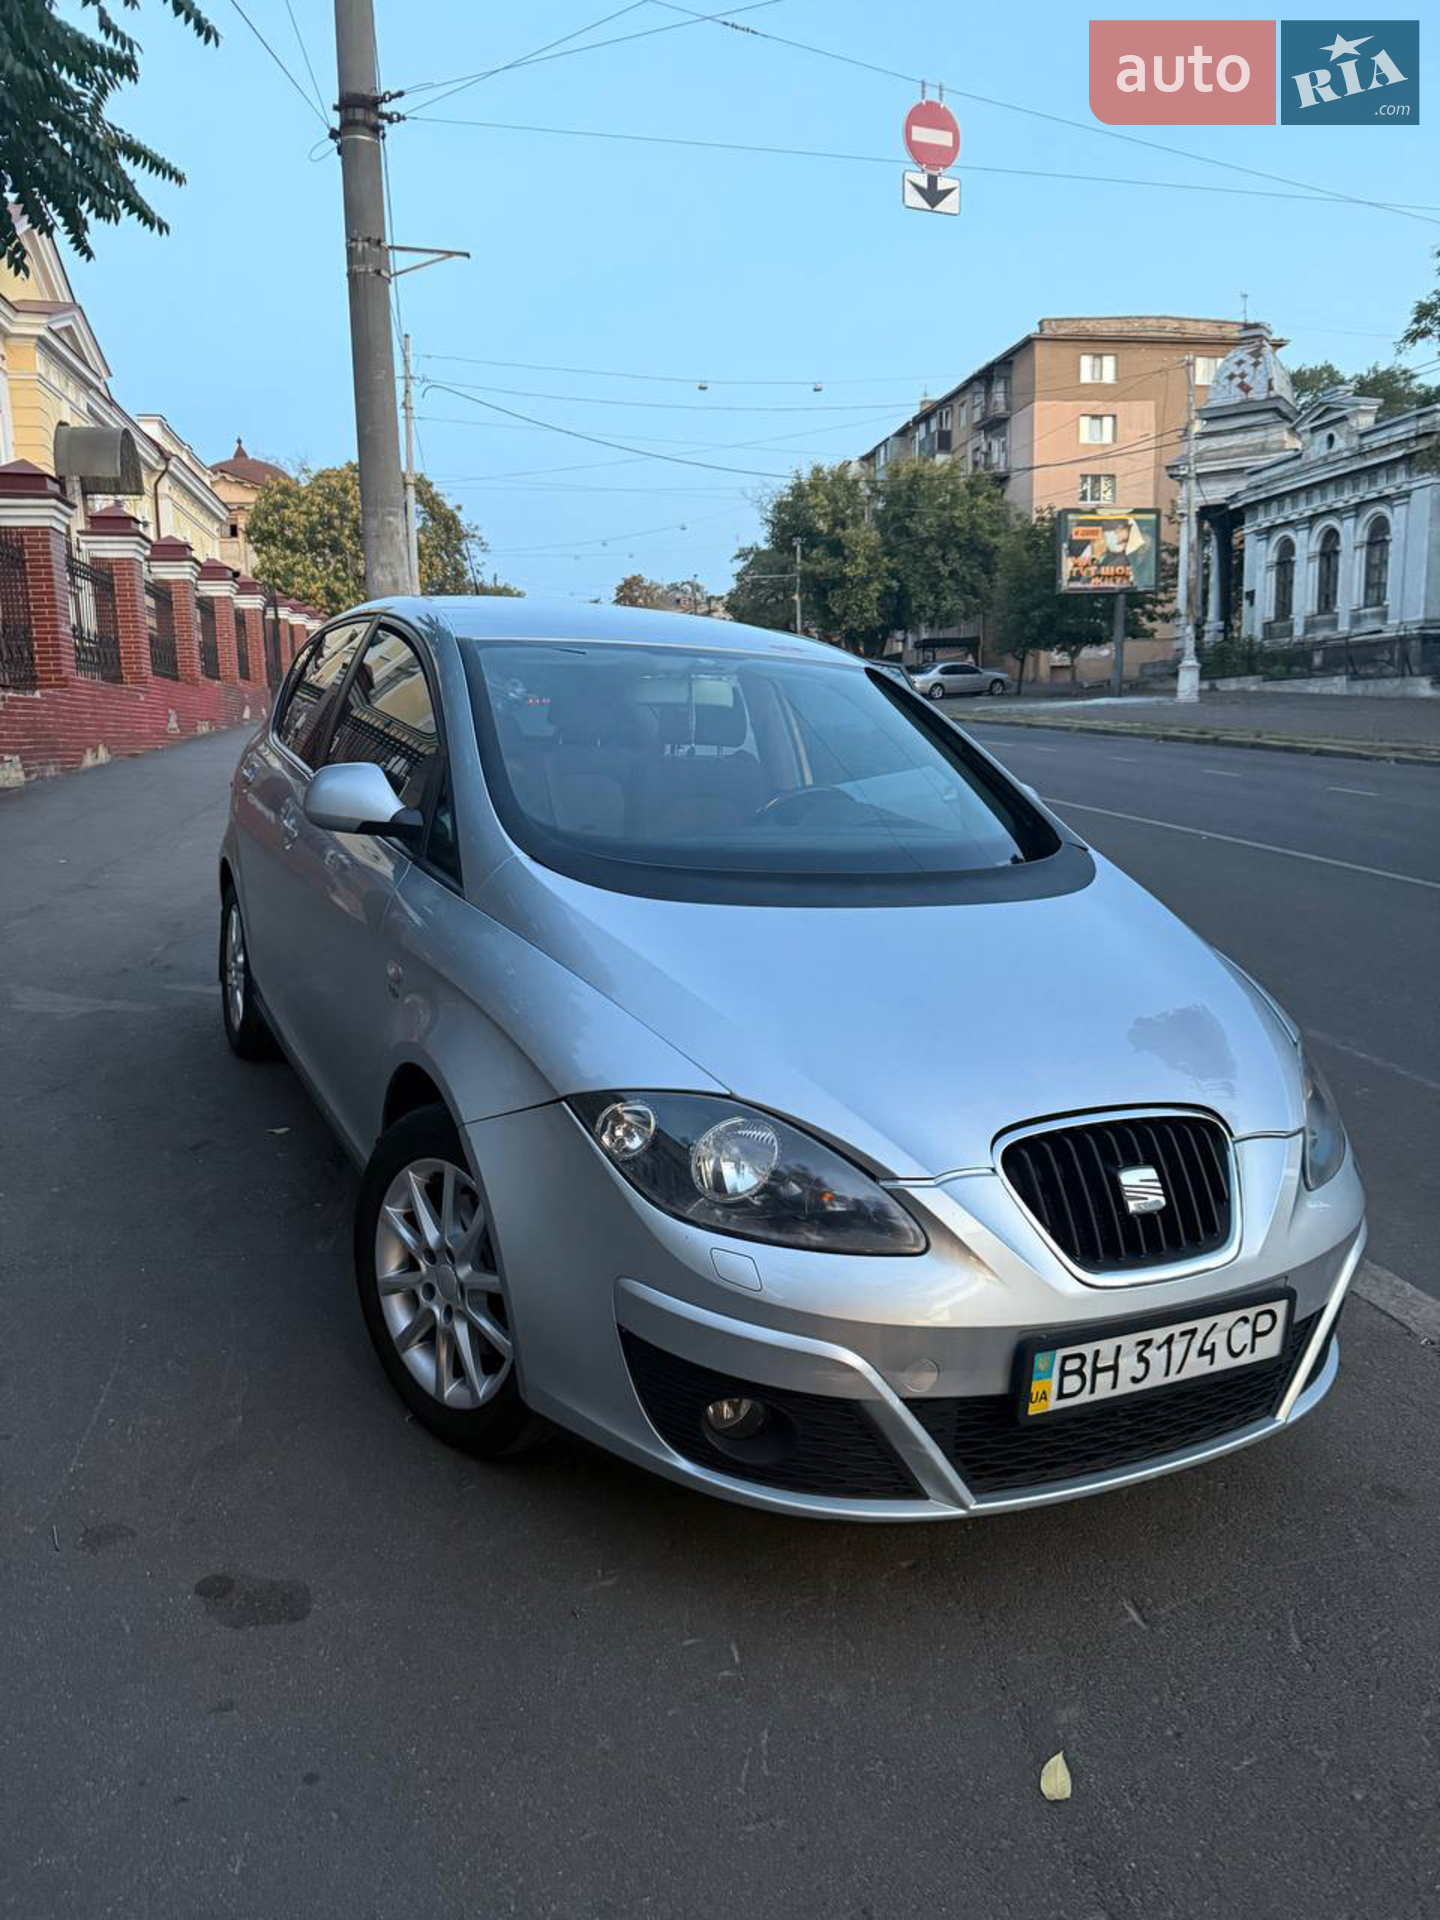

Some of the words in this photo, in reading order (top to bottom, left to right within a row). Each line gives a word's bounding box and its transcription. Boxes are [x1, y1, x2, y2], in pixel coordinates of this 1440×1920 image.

[1056, 1344, 1123, 1401] BH
[1130, 1322, 1218, 1384] 3174
[1226, 1308, 1278, 1359] CP
[1029, 1389, 1048, 1405] UA
